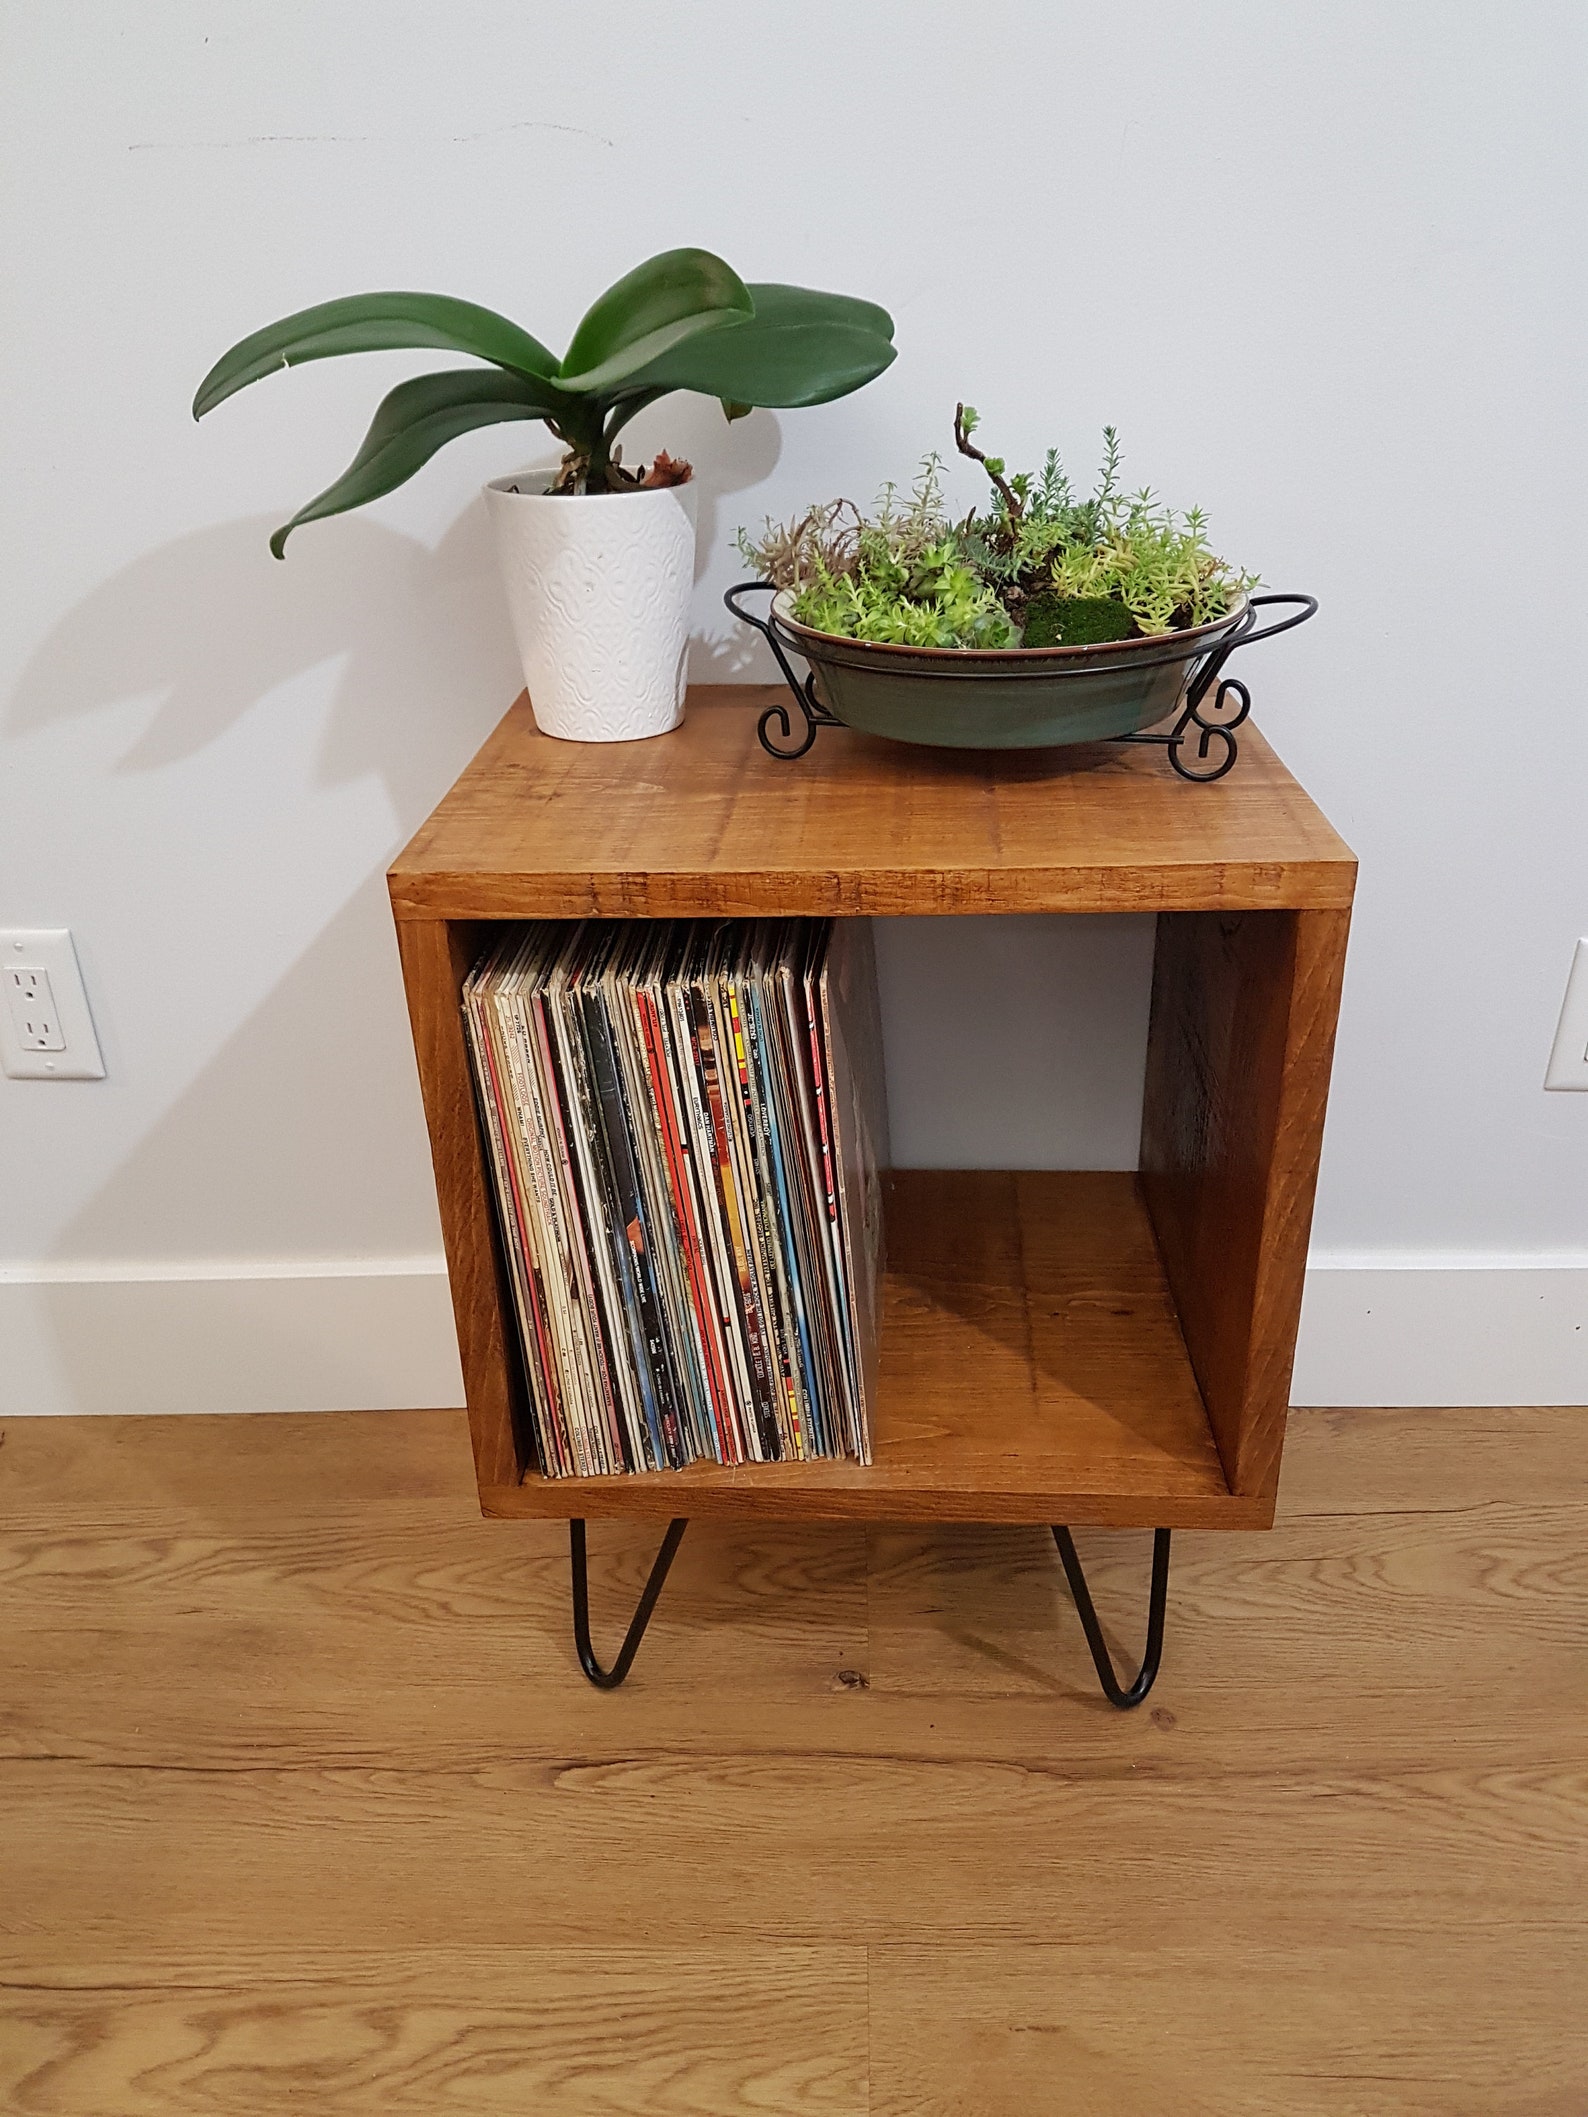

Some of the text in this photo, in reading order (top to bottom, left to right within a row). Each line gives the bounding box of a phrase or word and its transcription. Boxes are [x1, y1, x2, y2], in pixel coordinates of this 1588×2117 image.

[517, 1072, 529, 1105] FOOTLOOSE
[516, 1106, 525, 1126] WHAM!
[692, 1097, 702, 1129] EURYTHMICS
[746, 1113, 755, 1137] VERTIGO
[759, 1102, 770, 1136] LOVERBOY
[536, 1114, 546, 1139] MURPHY
[705, 1124, 714, 1152] HARTMAN
[522, 1137, 534, 1171] EVERYTHING
[531, 1184, 540, 1203] WANTS
[545, 1163, 554, 1182] COULD
[603, 1381, 611, 1406] SAMANTHA
[801, 1388, 810, 1417] COLUMBIA
[574, 1427, 583, 1452] COLUMBIA
[805, 1417, 813, 1439] STEREO
